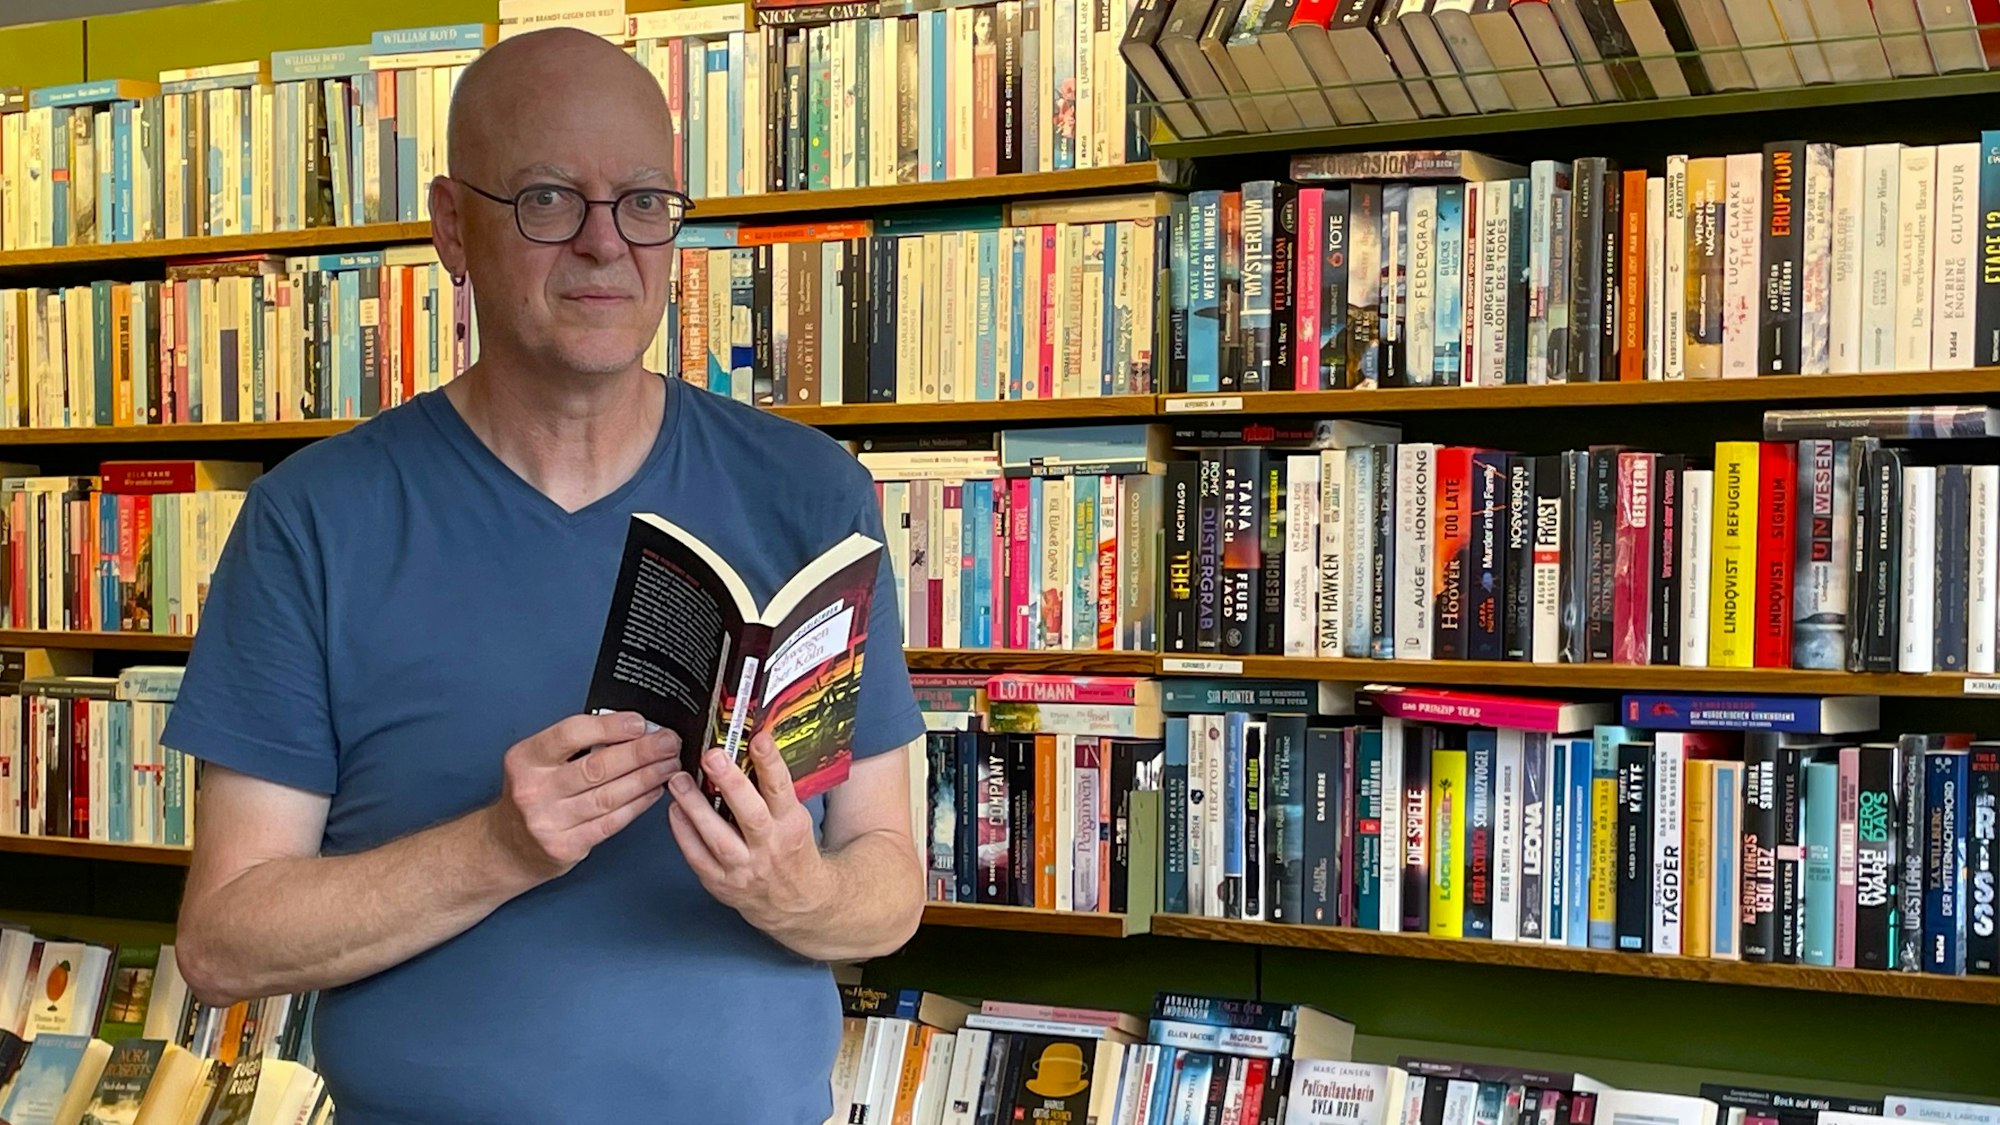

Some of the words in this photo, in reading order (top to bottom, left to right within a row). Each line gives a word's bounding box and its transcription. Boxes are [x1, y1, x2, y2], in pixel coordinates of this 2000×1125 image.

[536, 15, 560, 23] BRANDT
[758, 9, 796, 25] NICK
[829, 4, 868, 19] CAVE
[384, 30, 427, 44] WILLIAM
[431, 28, 457, 42] BOYD
[284, 52, 320, 65] WILLIAM
[1730, 181, 1740, 238] CLARKE
[1742, 196, 1754, 232] HIKE
[1772, 152, 1792, 236] ERUPTION
[1916, 180, 1927, 210] Braut
[1951, 164, 1965, 244] GLUTSPUR
[1191, 206, 1200, 265] ATKINSON
[1204, 203, 1216, 249] HIMMEL
[1330, 216, 1342, 251] TOTE
[1485, 219, 1496, 270] BREKKE
[1496, 219, 1507, 259] TODES
[1695, 210, 1703, 245] WENN
[1705, 213, 1715, 256] NACHT
[1244, 200, 1263, 295] MYSTERIUM
[1275, 237, 1285, 273] BLOM
[1415, 209, 1428, 298] FEDERGRAB
[1440, 241, 1449, 275] GLÜCKS
[1730, 247, 1738, 285] LUCY
[1741, 238, 1753, 266] THE
[1191, 271, 1200, 299] KATE
[1204, 255, 1215, 300] WEITER
[1275, 278, 1285, 310] FELIX
[1496, 266, 1505, 289] DES
[1944, 259, 1955, 319] KATRINE
[1955, 258, 1966, 318] ENGBERG
[1070, 265, 1081, 374] GRENZVERKEHR
[1484, 276, 1495, 326] JØRGEN
[1912, 308, 1923, 327] Die
[690, 327, 700, 359] HIER
[1495, 295, 1505, 352] MELODIE
[805, 323, 813, 381] FORTIER
[1278, 345, 1287, 366] Alex
[1494, 358, 1503, 379] DIE
[1210, 462, 1220, 496] ROMY
[1416, 450, 1427, 540] HONGKONG
[1445, 480, 1459, 510] LATE
[1484, 464, 1496, 499] Family
[1632, 459, 1647, 528] GEISTERN
[1224, 468, 1234, 542] FRENCH
[1239, 480, 1252, 530] TANA
[1483, 501, 1493, 518] the
[1727, 463, 1740, 536] REFUGIUM
[1771, 478, 1786, 539] SIGNUM
[1020, 506, 1028, 541] ENGEL
[1444, 514, 1457, 539] TOO
[1483, 520, 1492, 529] in
[1537, 496, 1557, 546] FROST
[1201, 507, 1218, 629] DÜSTERGRAB
[1483, 531, 1493, 568] Murder
[1101, 551, 1114, 594] Hornby
[1323, 554, 1338, 612] HAWKEN
[1375, 553, 1383, 593] HILMES
[1414, 567, 1425, 608] AUGE
[1101, 596, 1112, 623] Nick
[1224, 576, 1233, 617] JAGD
[1235, 573, 1248, 621] FEUER
[1441, 560, 1460, 629] HOOVER
[1724, 558, 1739, 634] LINDQVIST
[1769, 561, 1785, 637] LINDQVIST
[1322, 617, 1338, 649] SAM
[1374, 596, 1382, 634] OLIVER
[1878, 598, 1886, 636] MICHAEL
[1000, 681, 1075, 701] LOTTMANN
[1418, 703, 1455, 714] PRINZIP
[1282, 736, 1290, 768] House
[1601, 735, 1610, 774] BERND
[989, 756, 1004, 826] COMPANY
[1209, 758, 1218, 822] HERZTOD
[1318, 772, 1326, 798] ERBE
[1473, 750, 1489, 827] SCHWARZVOGEL
[1627, 763, 1645, 813] KÄLTE
[1669, 758, 1677, 813] WASSERS
[1747, 764, 1759, 804] THIELE
[1760, 761, 1773, 809] MARKUS
[1077, 774, 1096, 853] Pergament
[1408, 789, 1425, 837] SPIELE
[1659, 817, 1667, 837] DAS
[1785, 774, 1795, 843] JAGDREVIER
[1860, 791, 1873, 842] ZERO
[1874, 792, 1887, 842] DAYS
[1407, 840, 1423, 865] DIE
[1440, 793, 1452, 901] LOCKVOGEL
[1523, 801, 1542, 875] LEONA
[1943, 781, 1954, 893] MITTERNACHTSMORD
[1319, 858, 1327, 902] SANDBERG
[1501, 849, 1510, 873] SMITH
[1743, 834, 1757, 925] SCHULDIGEN
[1757, 847, 1774, 880] ZEIT
[1858, 848, 1873, 906] RUTH
[1874, 851, 1887, 906] WARE
[1662, 845, 1679, 927] TÄGDER
[1757, 885, 1774, 912] DER
[1784, 863, 1792, 910] TURSTEN
[1904, 855, 1921, 930] WESTLAKE
[1942, 895, 1953, 916] DER
[1783, 915, 1792, 955] HELENE
[1165, 995, 1210, 1009] ARNALDUR
[1167, 1030, 1188, 1040] ELLEN
[1230, 1032, 1263, 1044] MORDS
[229, 1077, 258, 1095] RUGE
[1301, 1079, 1374, 1102] Polizeitaucherin
[1313, 1066, 1336, 1074] MARC
[1339, 1067, 1371, 1077] JANSEN
[1312, 1099, 1333, 1115] SVEA
[1336, 1101, 1360, 1118] ROTH
[1773, 1094, 1794, 1107] Bock
[1810, 1099, 1830, 1111] Wild
